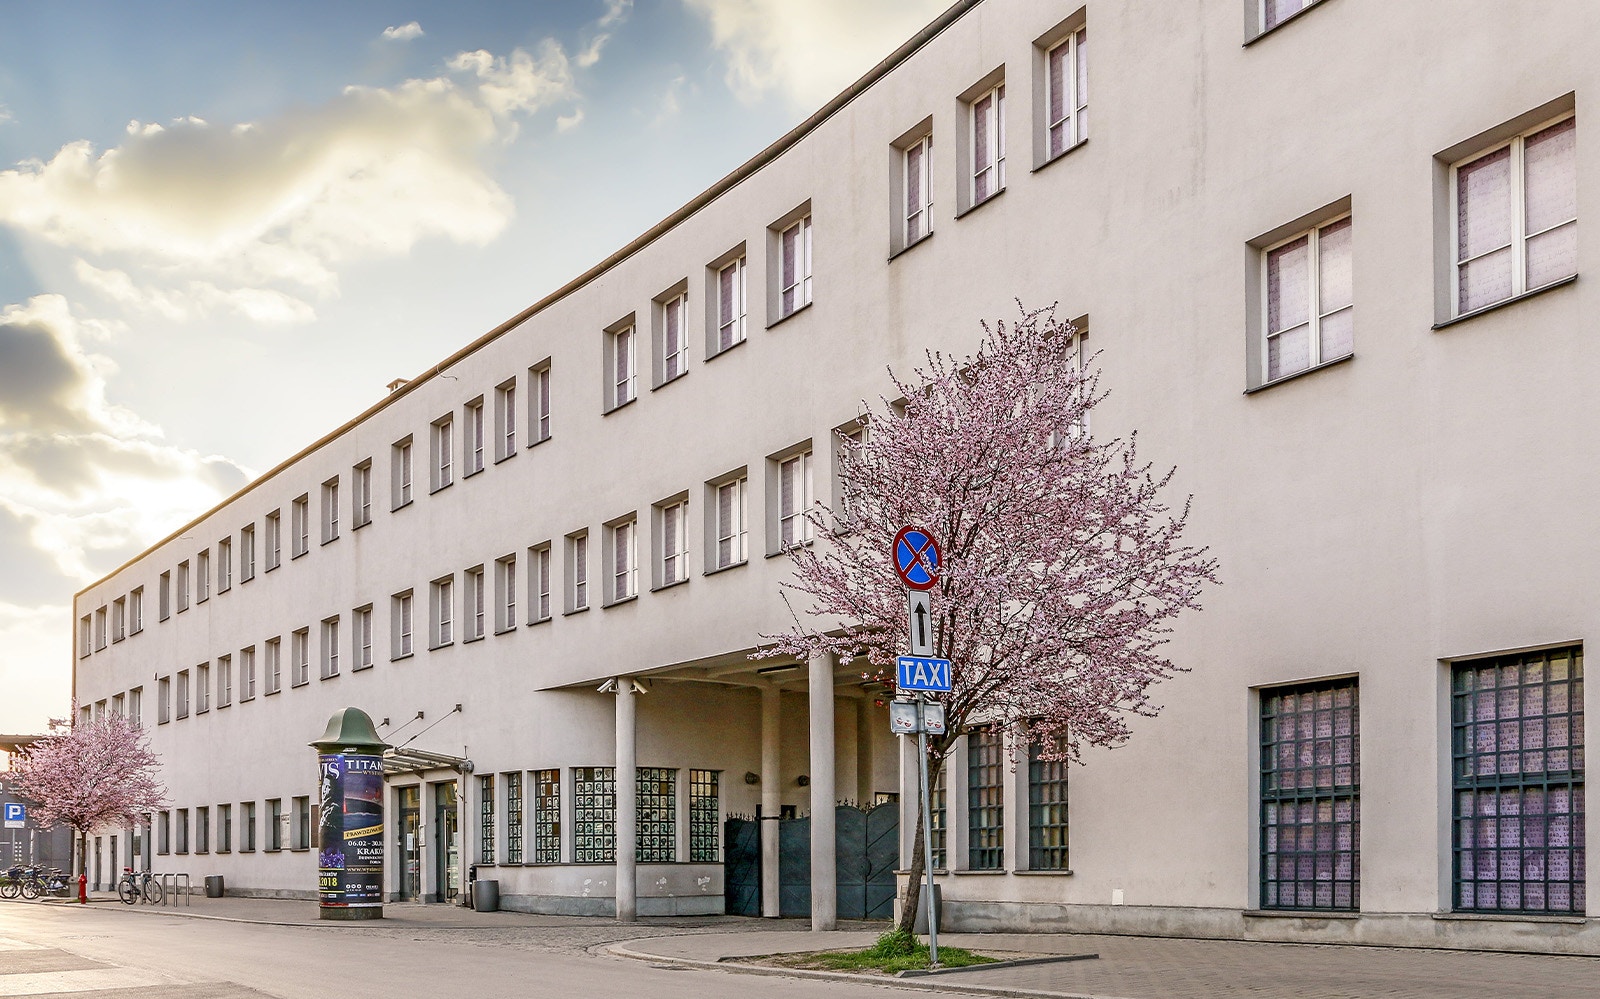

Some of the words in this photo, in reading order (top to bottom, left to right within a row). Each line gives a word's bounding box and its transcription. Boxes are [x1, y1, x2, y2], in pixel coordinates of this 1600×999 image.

[901, 661, 949, 687] TAXI
[344, 760, 383, 771] TITAN
[9, 805, 21, 819] P
[357, 847, 383, 855] KRAKÓ
